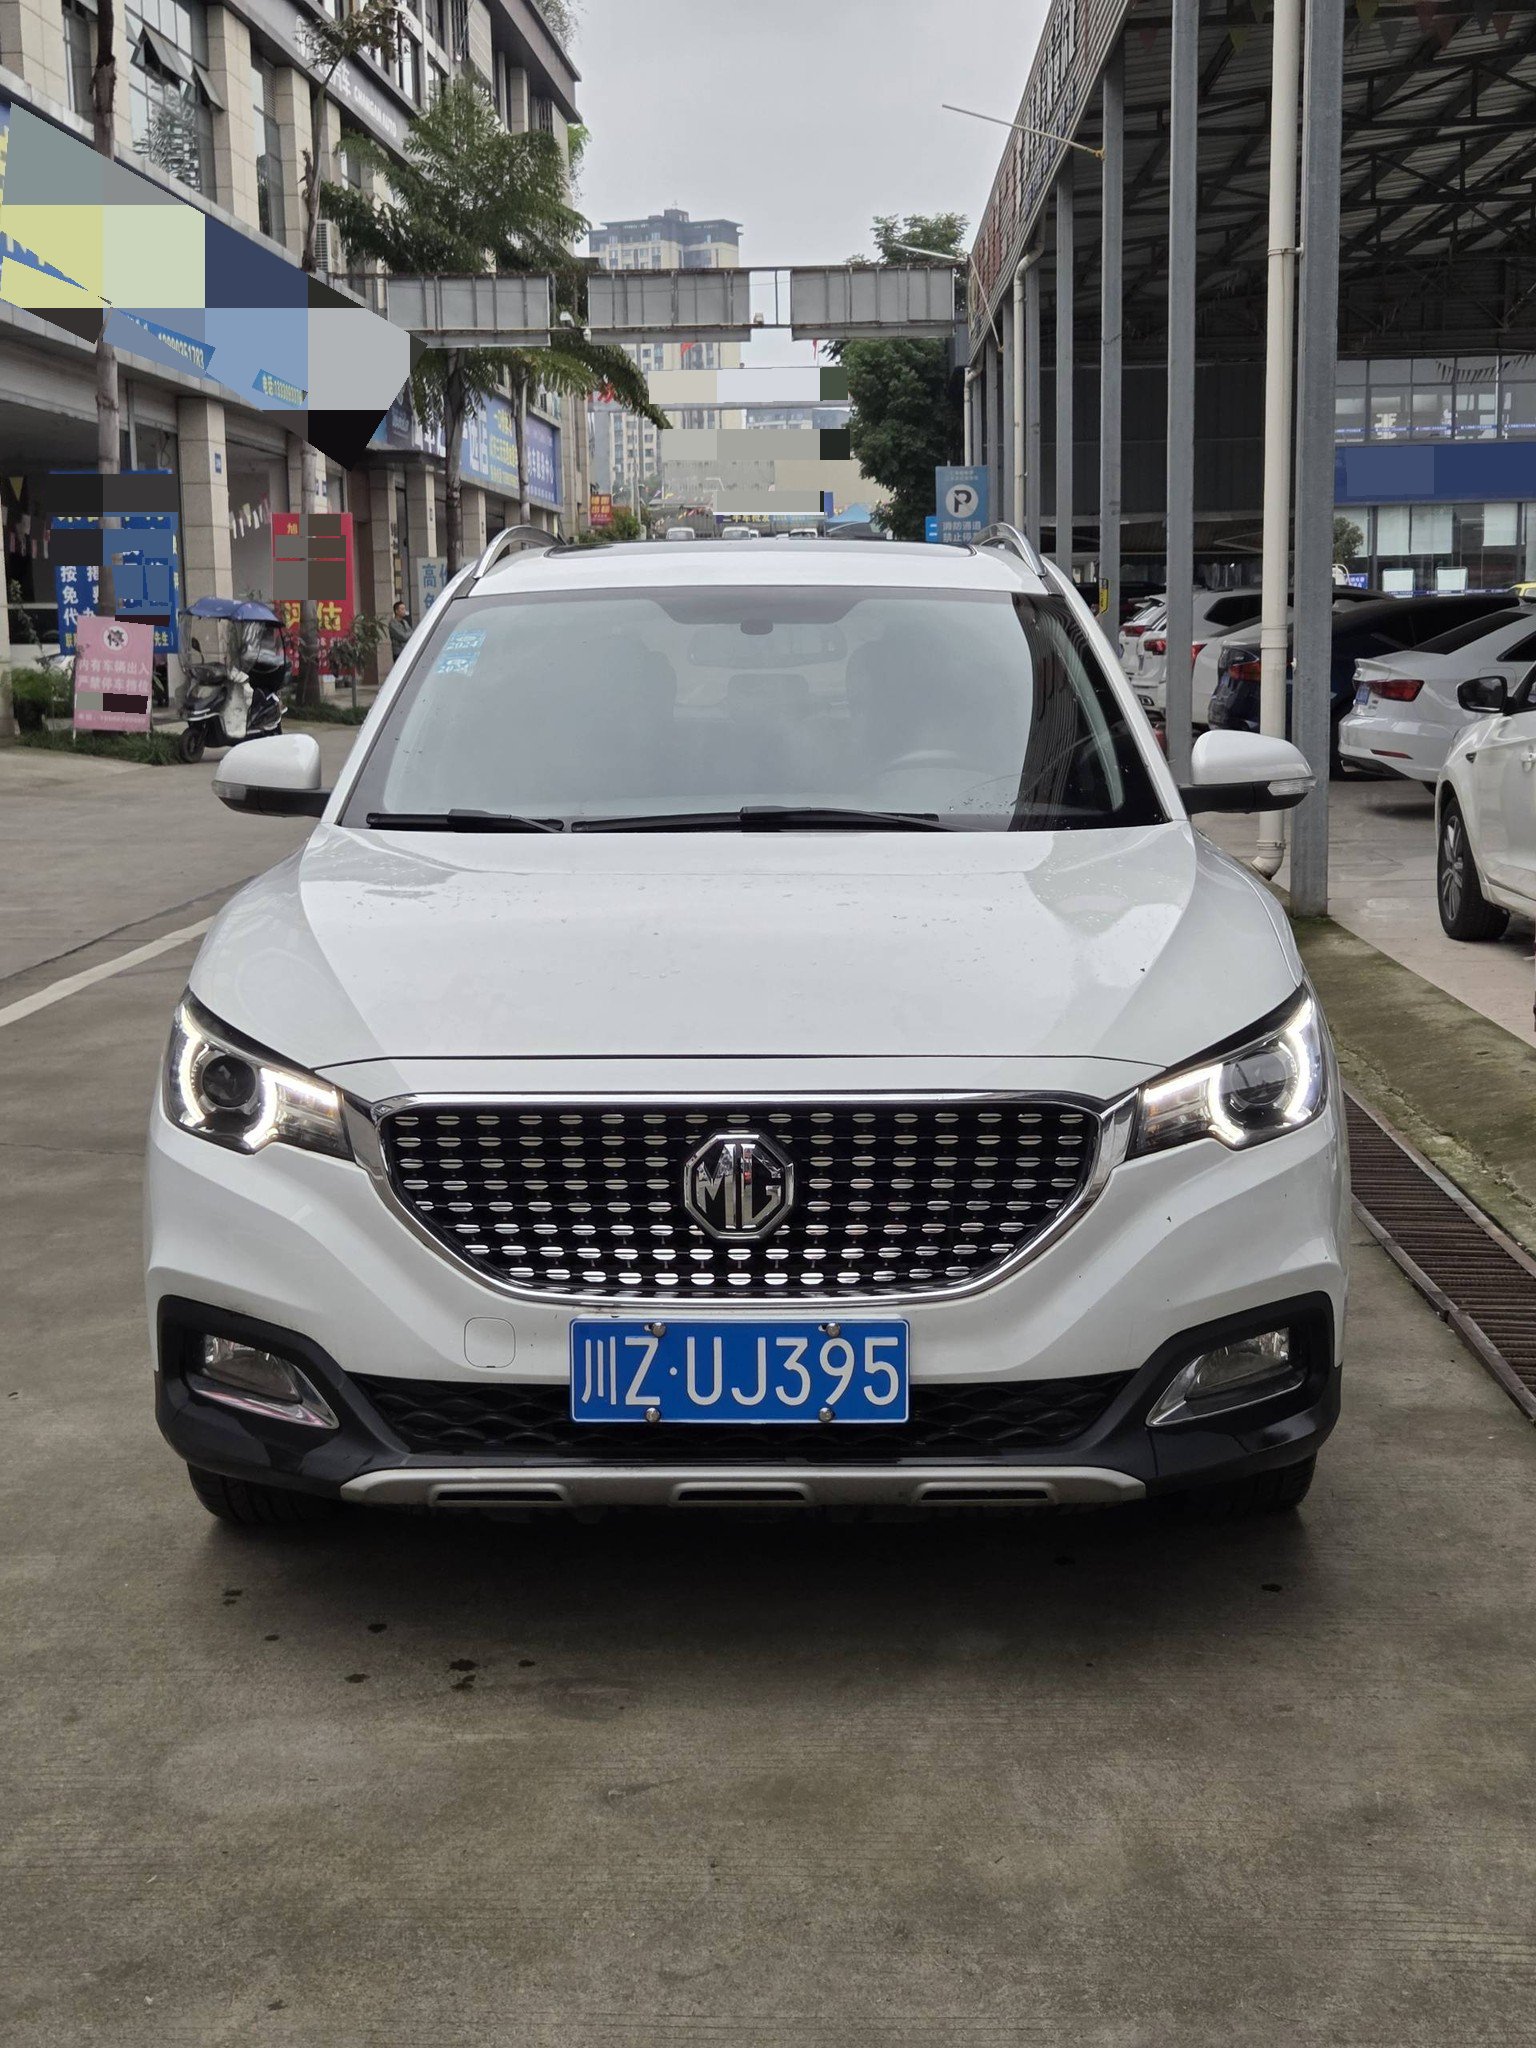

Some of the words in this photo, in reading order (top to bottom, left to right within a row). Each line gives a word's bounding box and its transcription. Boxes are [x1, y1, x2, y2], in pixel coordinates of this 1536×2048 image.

[954, 490, 972, 513] P
[942, 532, 979, 543] 禁止停
[696, 1143, 782, 1229] MG
